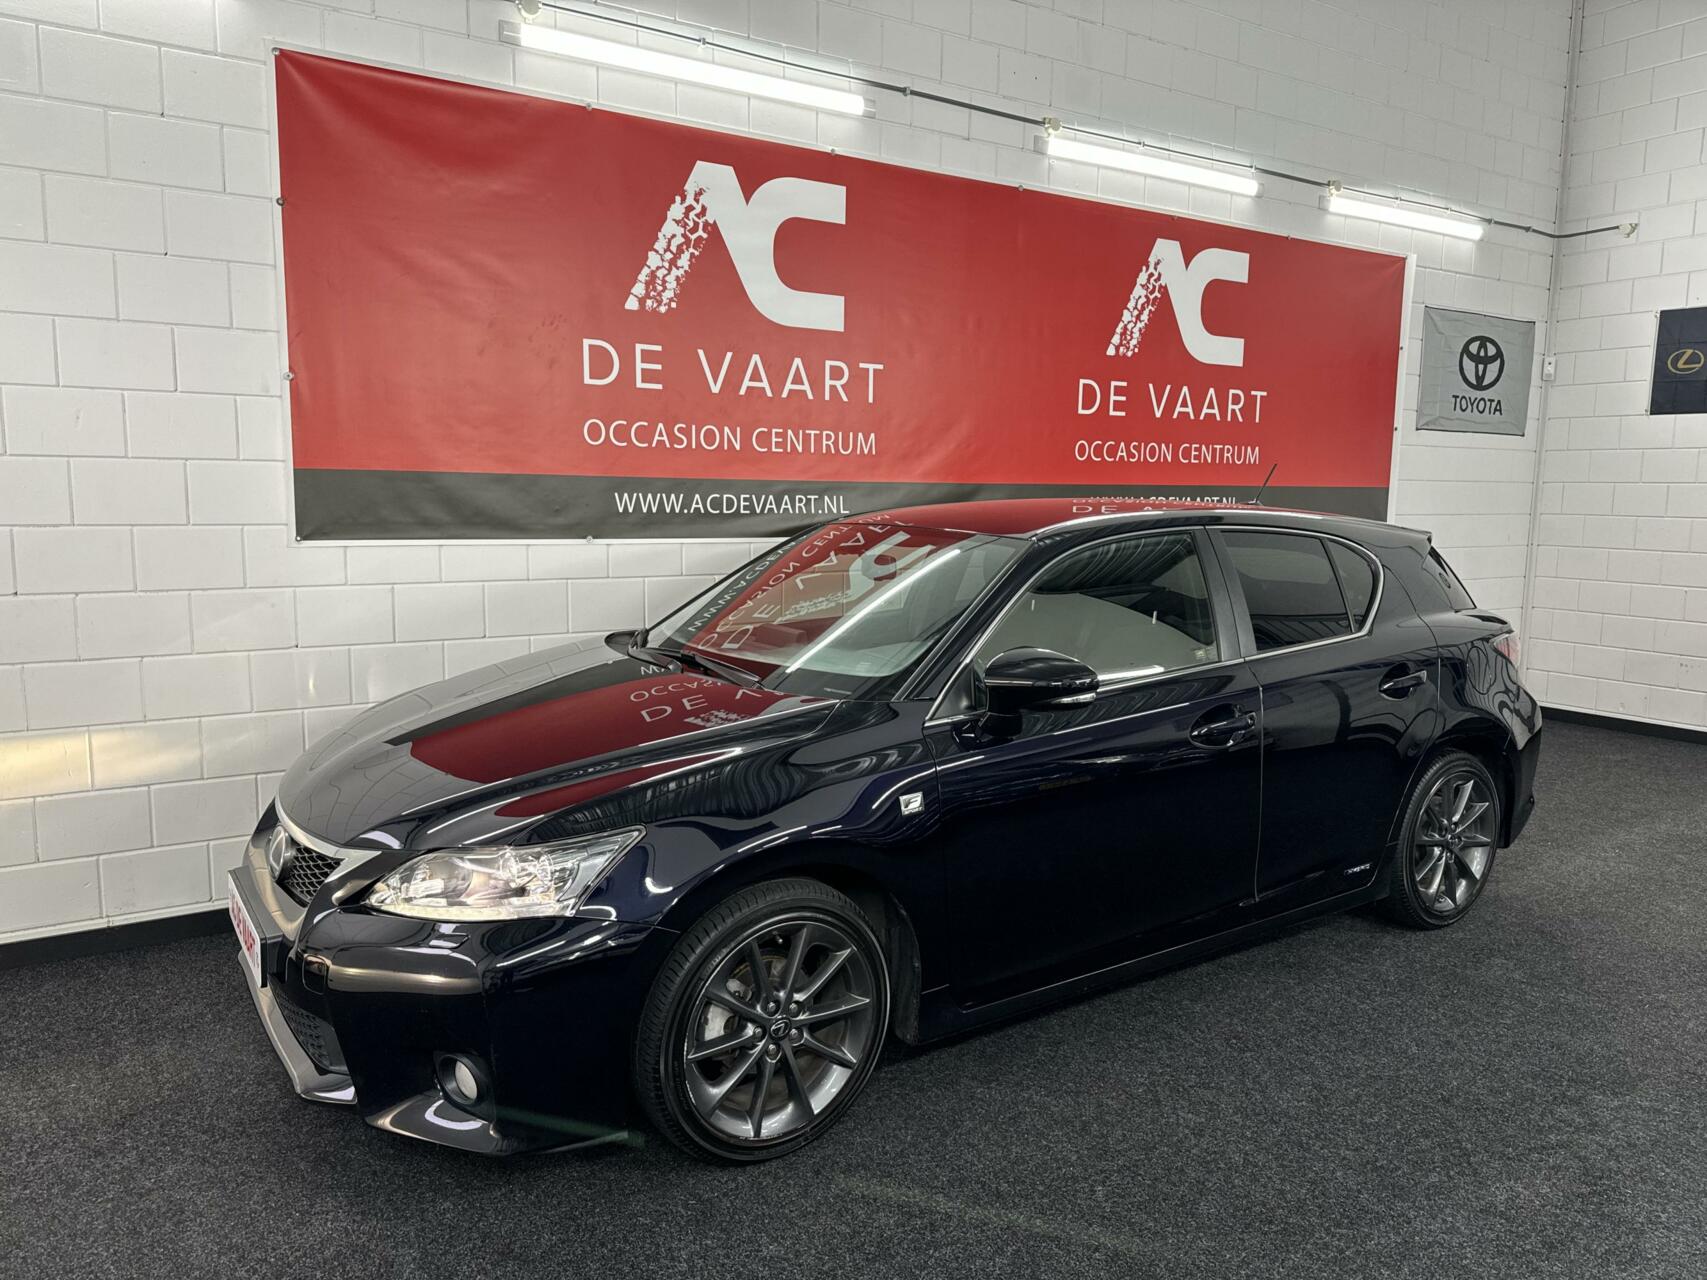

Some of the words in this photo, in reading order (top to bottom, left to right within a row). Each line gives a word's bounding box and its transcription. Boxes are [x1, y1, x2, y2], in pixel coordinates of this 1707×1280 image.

[624, 160, 846, 332] AC
[1106, 238, 1250, 367] AC
[583, 338, 663, 390] DE
[697, 349, 884, 403] VAART
[1077, 378, 1127, 416] DE
[1148, 383, 1267, 423] VAART
[1452, 394, 1503, 416] TOYOTA
[583, 418, 741, 450] OCCASION
[752, 428, 876, 455] CENTRUM
[1075, 440, 1172, 463] OCCASION
[1179, 443, 1259, 464] CENTRUM
[615, 492, 849, 514] WWW.ACDEVAART.NL
